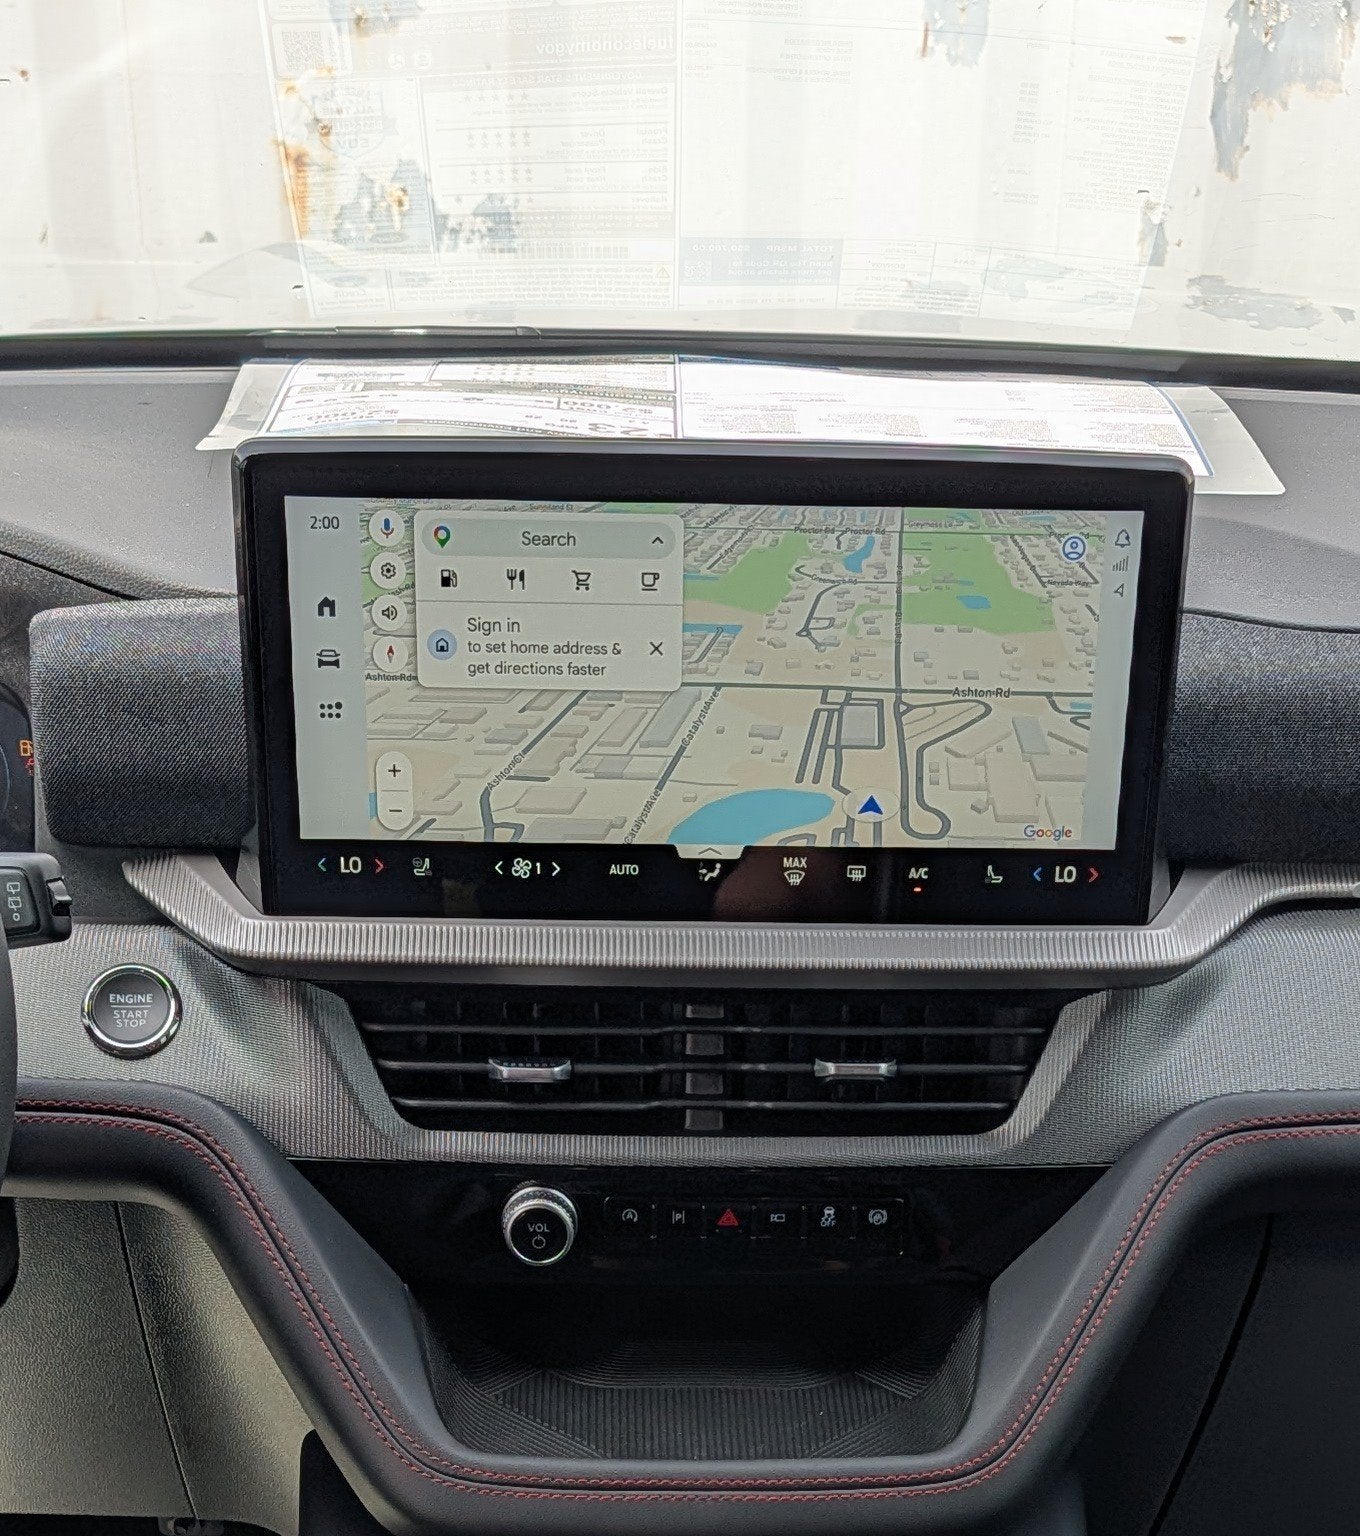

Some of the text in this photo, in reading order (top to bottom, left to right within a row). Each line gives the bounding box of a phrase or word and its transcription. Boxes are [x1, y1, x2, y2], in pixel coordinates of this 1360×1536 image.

[310, 515, 340, 531] 2:00
[794, 526, 836, 536] Proctor Rd
[845, 527, 886, 536] Proctor Rd
[521, 530, 577, 548] Search
[467, 617, 521, 635] Sign in
[467, 640, 623, 656] to set home address &
[467, 661, 607, 678] get directions faster
[952, 686, 1011, 699] Ashton Rd
[681, 706, 710, 748] Catalyst
[487, 760, 516, 791] Ashton
[625, 806, 653, 846] Catalyst
[1023, 824, 1073, 841] Google
[340, 856, 362, 874] LO
[535, 861, 542, 874] 1
[783, 856, 808, 869] MAX
[609, 863, 640, 876] AUTO
[908, 867, 929, 880] A/C
[1054, 865, 1077, 883] LO
[109, 993, 154, 1004] ENGINE
[113, 1009, 149, 1019] START
[116, 1019, 146, 1028] STOP
[527, 1223, 551, 1233] VOL
[820, 1219, 837, 1228] OFF
